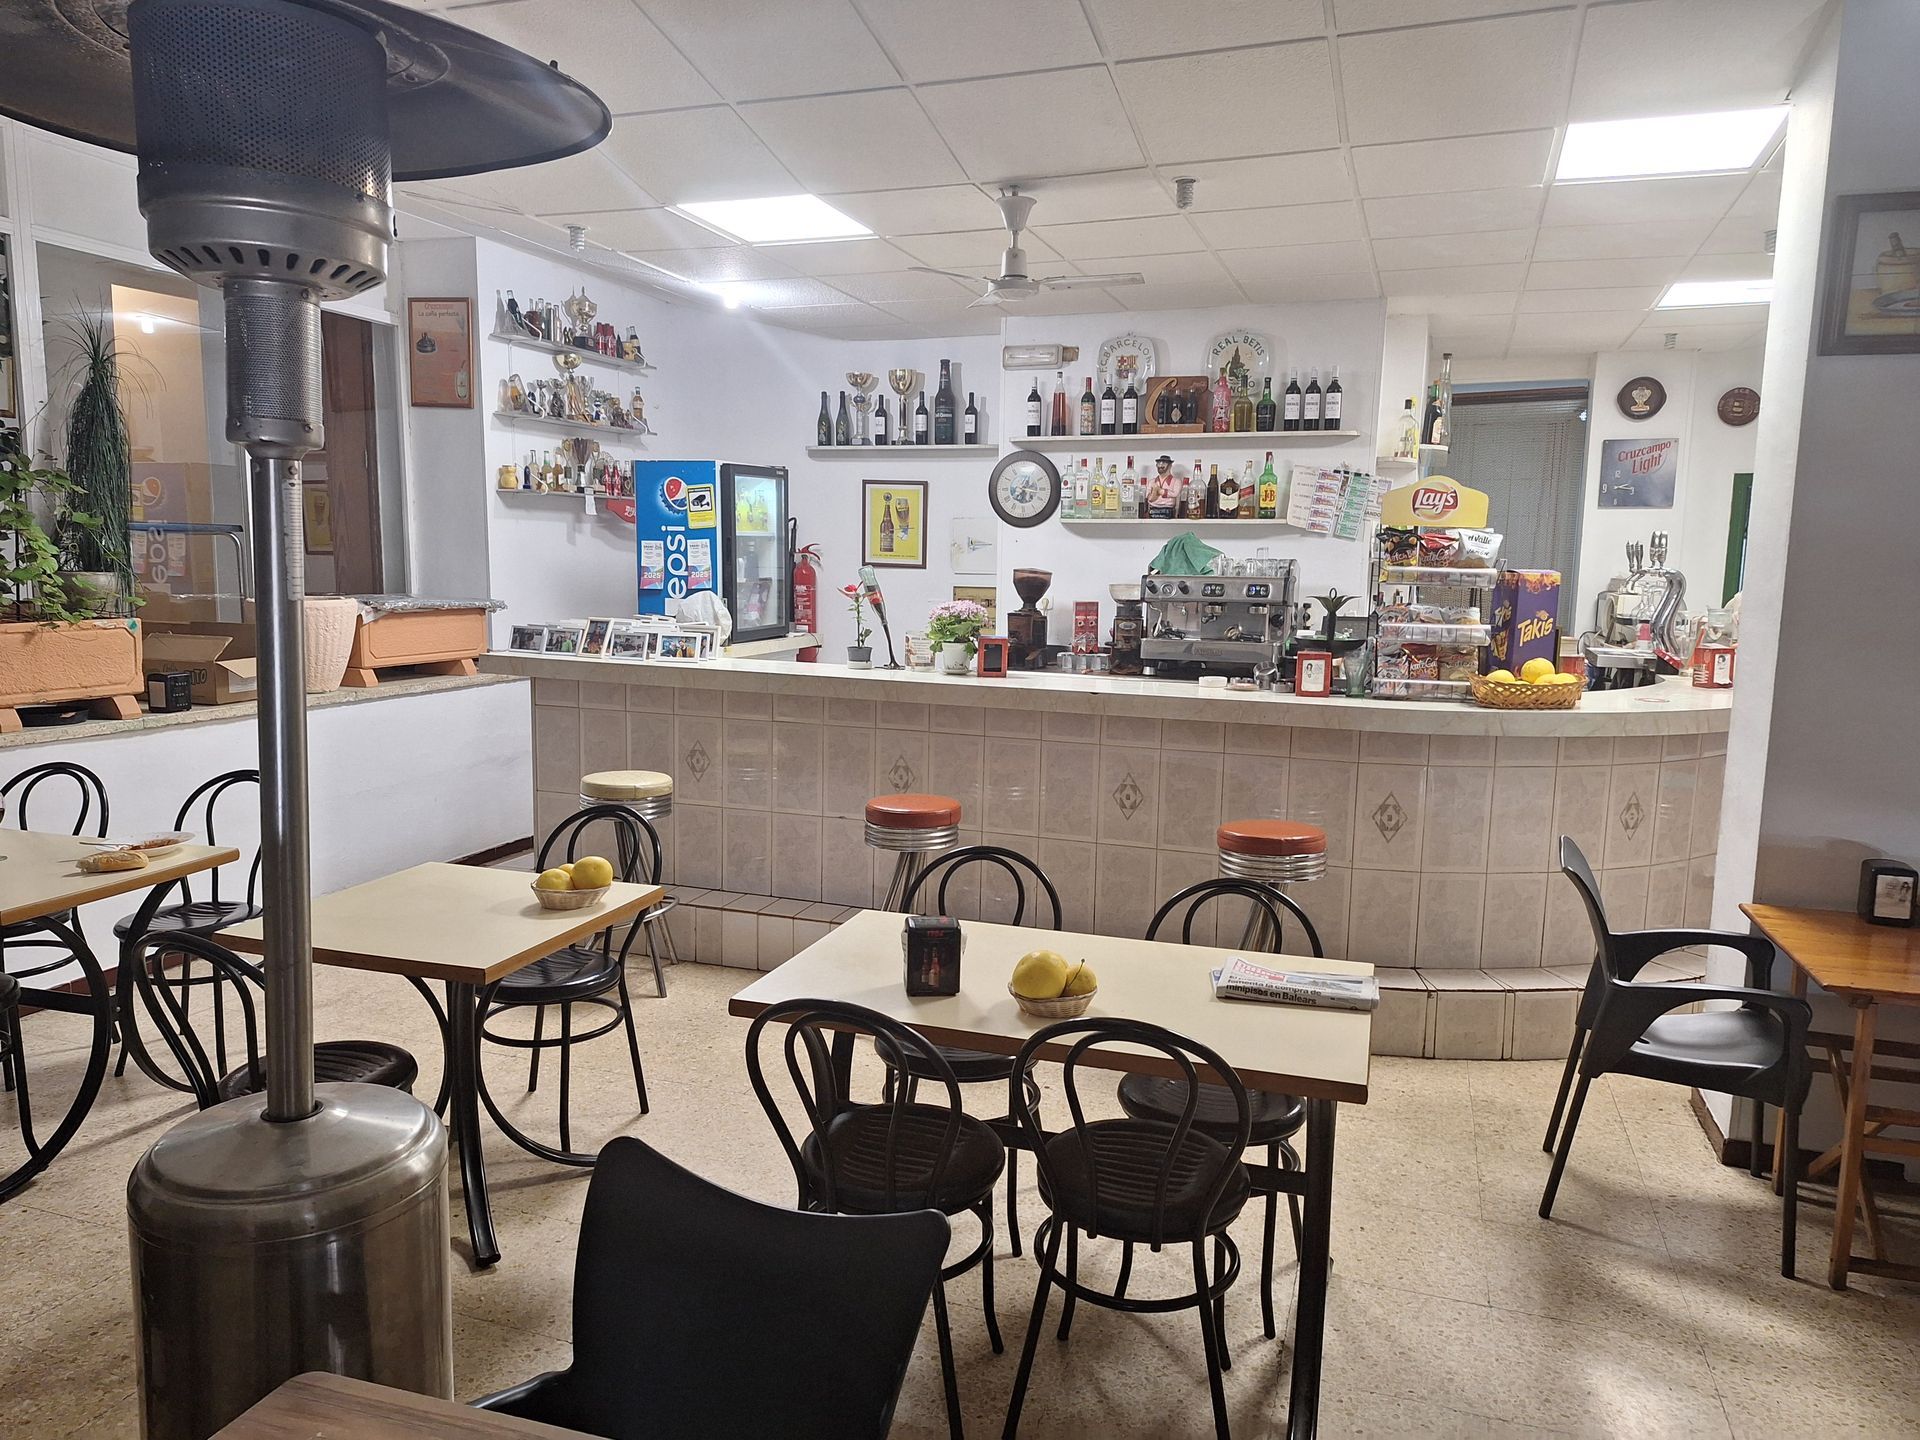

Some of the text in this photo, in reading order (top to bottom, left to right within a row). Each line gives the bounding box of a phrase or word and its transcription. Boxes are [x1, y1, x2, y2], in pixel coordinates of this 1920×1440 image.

[1212, 335, 1265, 356] REAL BETIS
[1617, 441, 1672, 463] Cruzcampo
[1631, 453, 1662, 475] Light
[1261, 489, 1276, 502] J&B
[1414, 488, 1457, 514] Lay's
[661, 525, 688, 600] epsi
[643, 571, 661, 579] 2025
[691, 571, 709, 579] 2025
[1517, 617, 1554, 647] Takis
[1226, 983, 1317, 1006] minipisos en Balears
[1227, 979, 1264, 988] fomenta
[1275, 984, 1309, 996] compra
